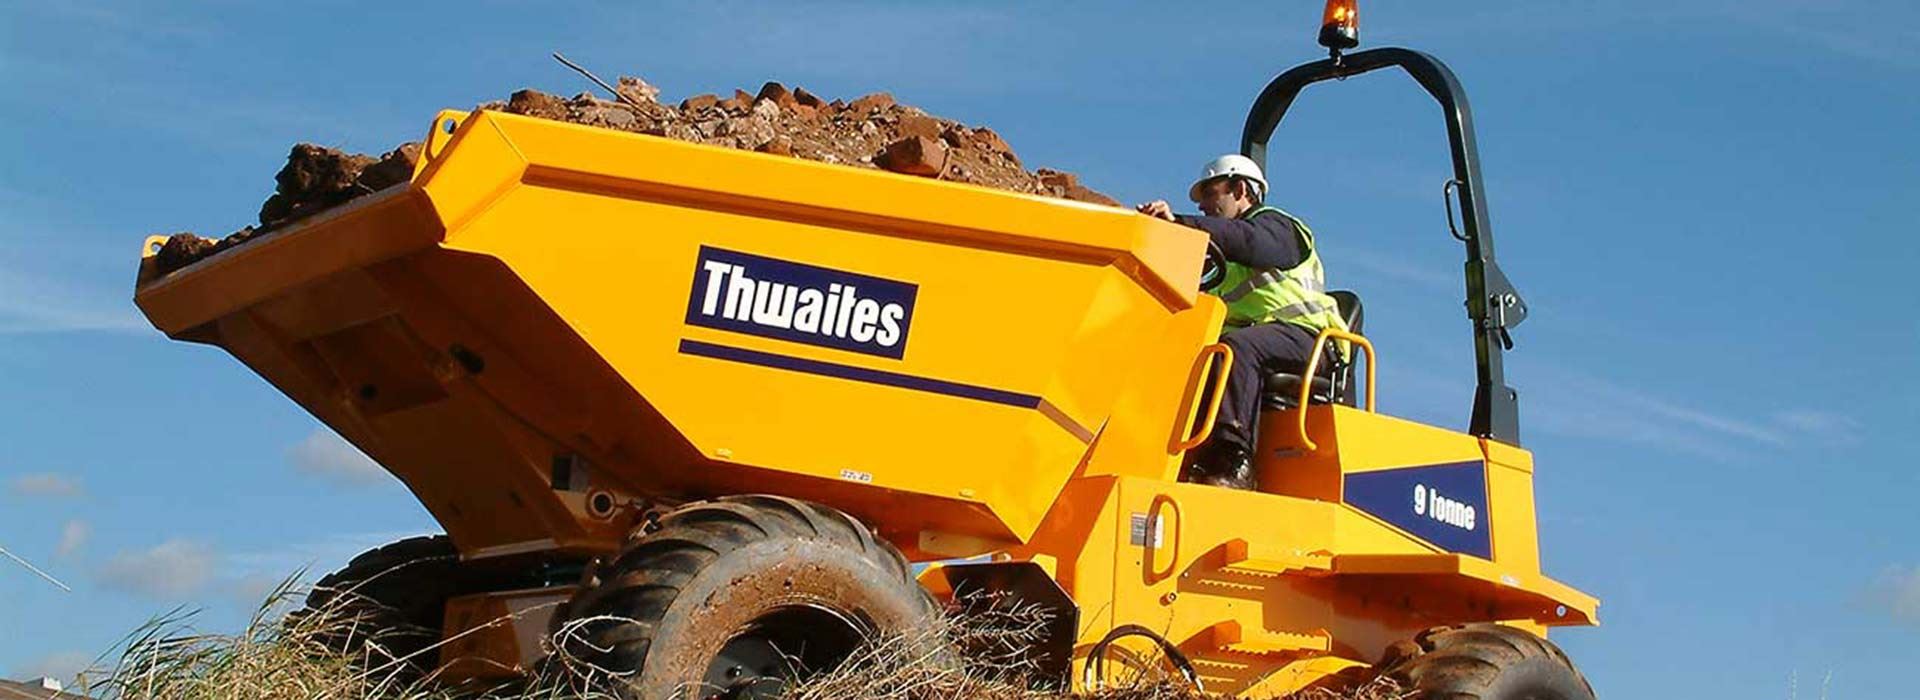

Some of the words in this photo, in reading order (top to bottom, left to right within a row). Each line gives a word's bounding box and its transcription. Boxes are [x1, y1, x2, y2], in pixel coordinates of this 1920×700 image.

[702, 260, 905, 347] Thwaites
[1414, 484, 1426, 515] 9
[1429, 488, 1475, 531] tonne
